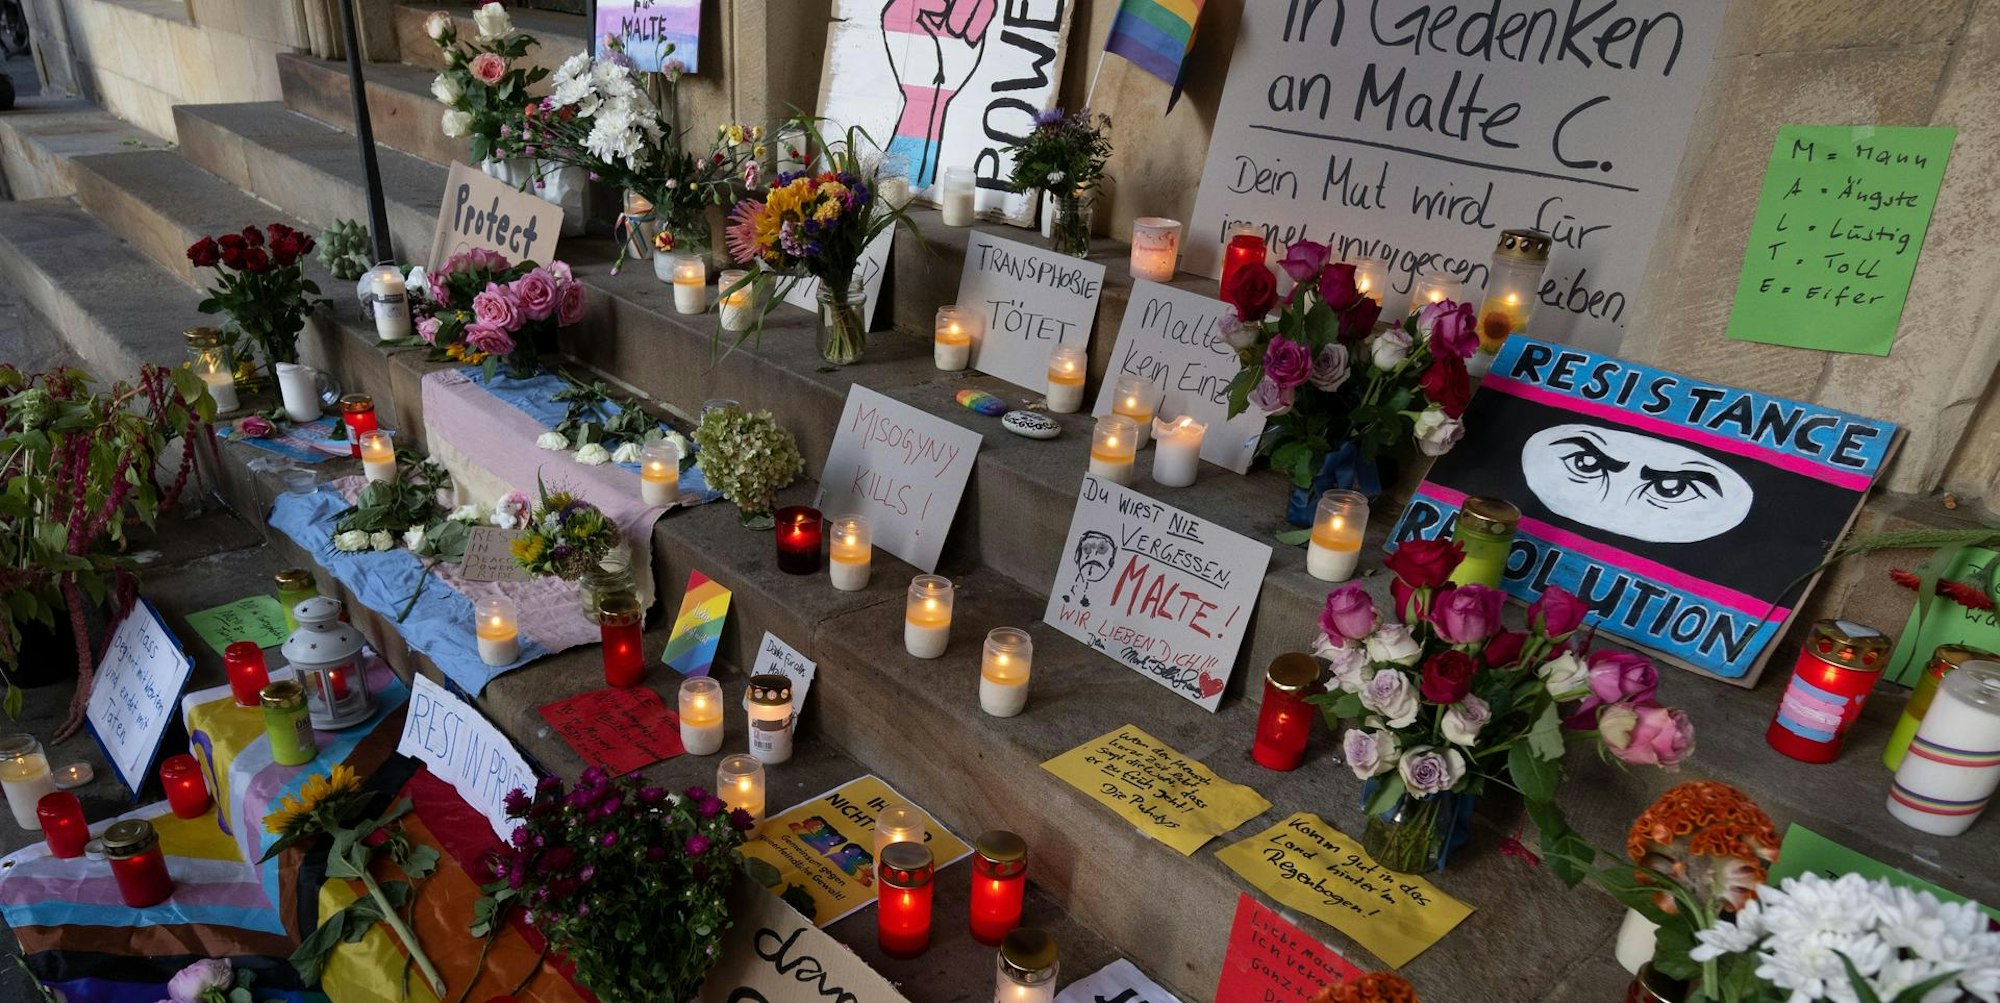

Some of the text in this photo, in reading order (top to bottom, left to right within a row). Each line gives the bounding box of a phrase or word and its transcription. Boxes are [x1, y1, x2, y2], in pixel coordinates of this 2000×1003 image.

[621, 14, 667, 43] MALTE
[1370, 0, 1685, 77] Gedenken
[1267, 63, 1614, 174] an Malte C.
[1792, 138, 1815, 162] M
[1227, 154, 1299, 200] Dein
[1322, 154, 1389, 211] Mut
[1411, 182, 1498, 231] wird
[1783, 177, 1803, 200] A
[454, 183, 538, 260] Protect
[1776, 213, 1788, 232] L
[977, 243, 1100, 300] TRANSPHOBIE
[1768, 241, 1788, 261] T
[1759, 277, 1776, 293] E
[986, 299, 1078, 344] TÖTET
[1510, 341, 1882, 472] RESISTANCE
[851, 402, 960, 479] MISOGYNY
[1083, 476, 1202, 541] Du WIRST NIE
[1110, 553, 1241, 640] MALTE!
[1396, 499, 1760, 665] ROLUTION
[136, 615, 160, 659] Hass
[1060, 603, 1092, 630] WIR
[1097, 619, 1156, 652] LIEBEN
[101, 696, 126, 746] Taten
[408, 693, 464, 767] REST
[462, 728, 487, 789] IN
[825, 793, 876, 828] NICHT
[1100, 783, 1127, 800] Die
[781, 834, 847, 887] Gemeinsam gegen
[1269, 833, 1319, 860] Land
[1287, 818, 1432, 907] Komm gut in das
[1262, 848, 1381, 919] Regenbogen!
